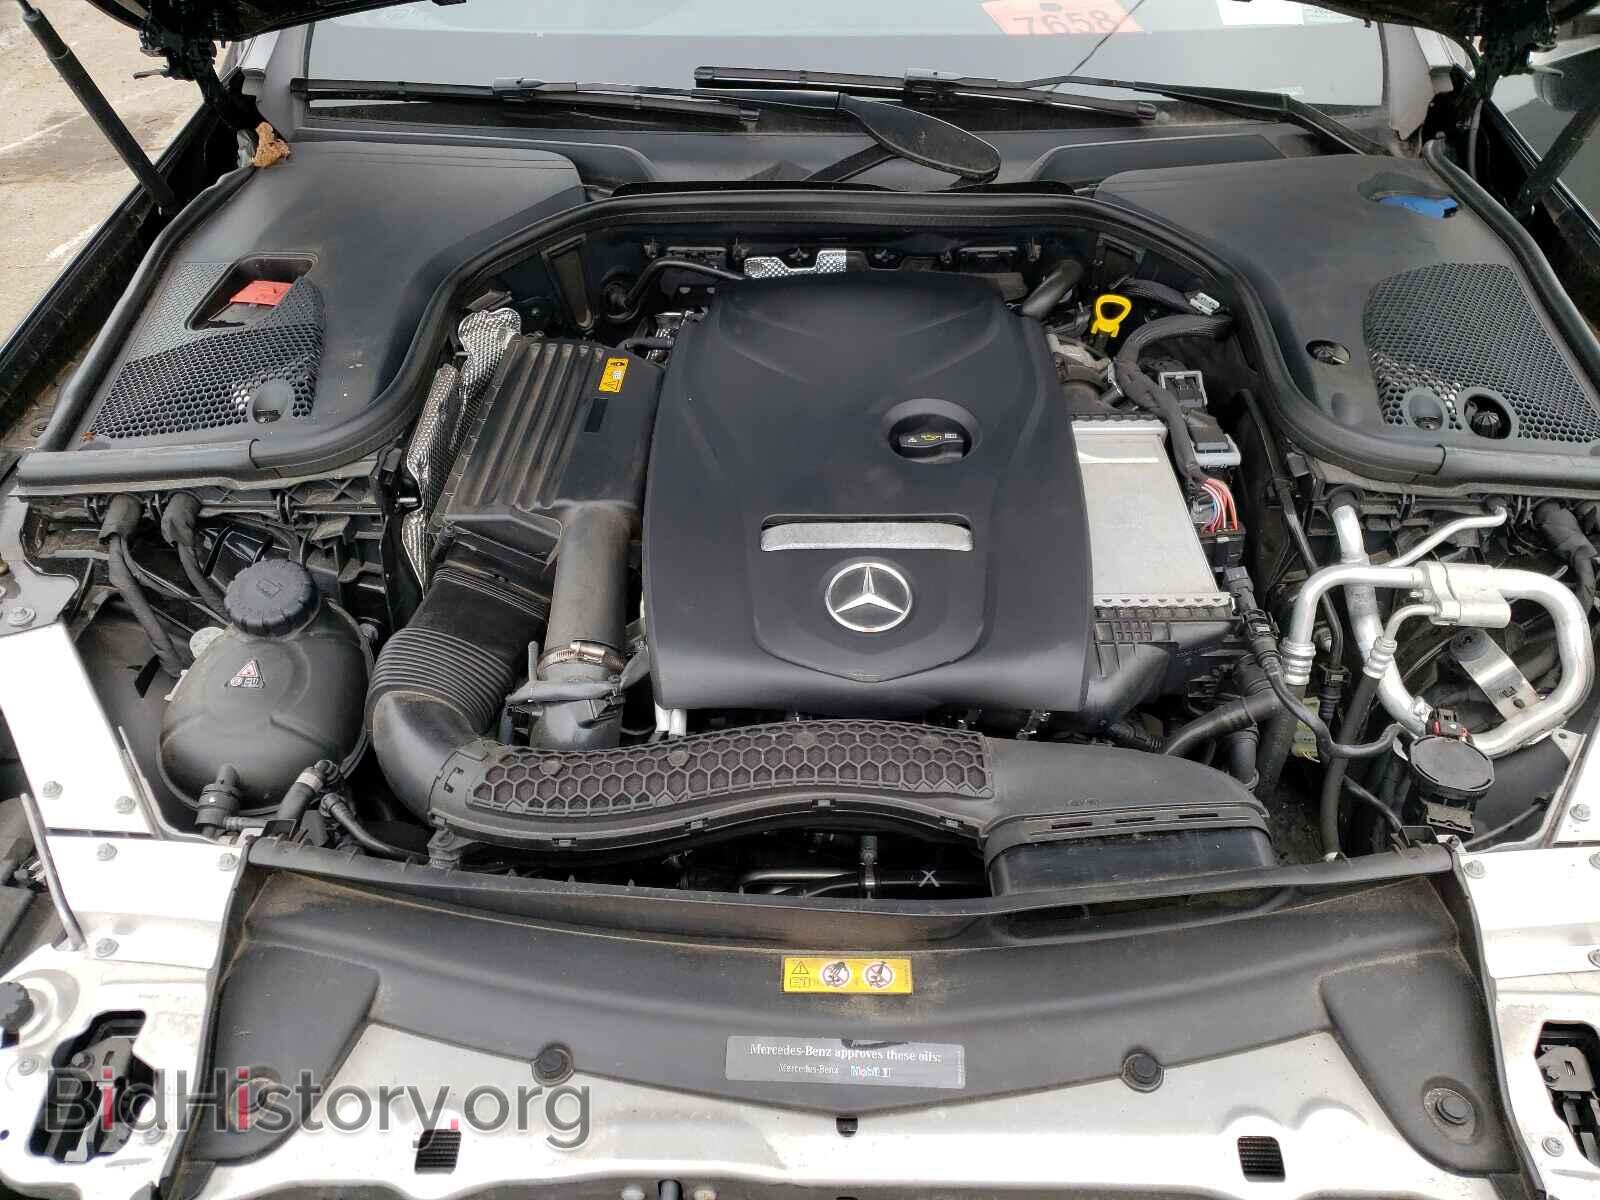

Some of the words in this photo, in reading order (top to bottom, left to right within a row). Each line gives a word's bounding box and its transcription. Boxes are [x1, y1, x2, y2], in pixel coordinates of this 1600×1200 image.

[1012, 10, 1117, 36] 7658
[750, 1043, 832, 1057] Mercedes-Benz
[834, 1047, 883, 1061] approves
[886, 1048, 915, 1062] these
[779, 1063, 839, 1074] Mercedes-Benz
